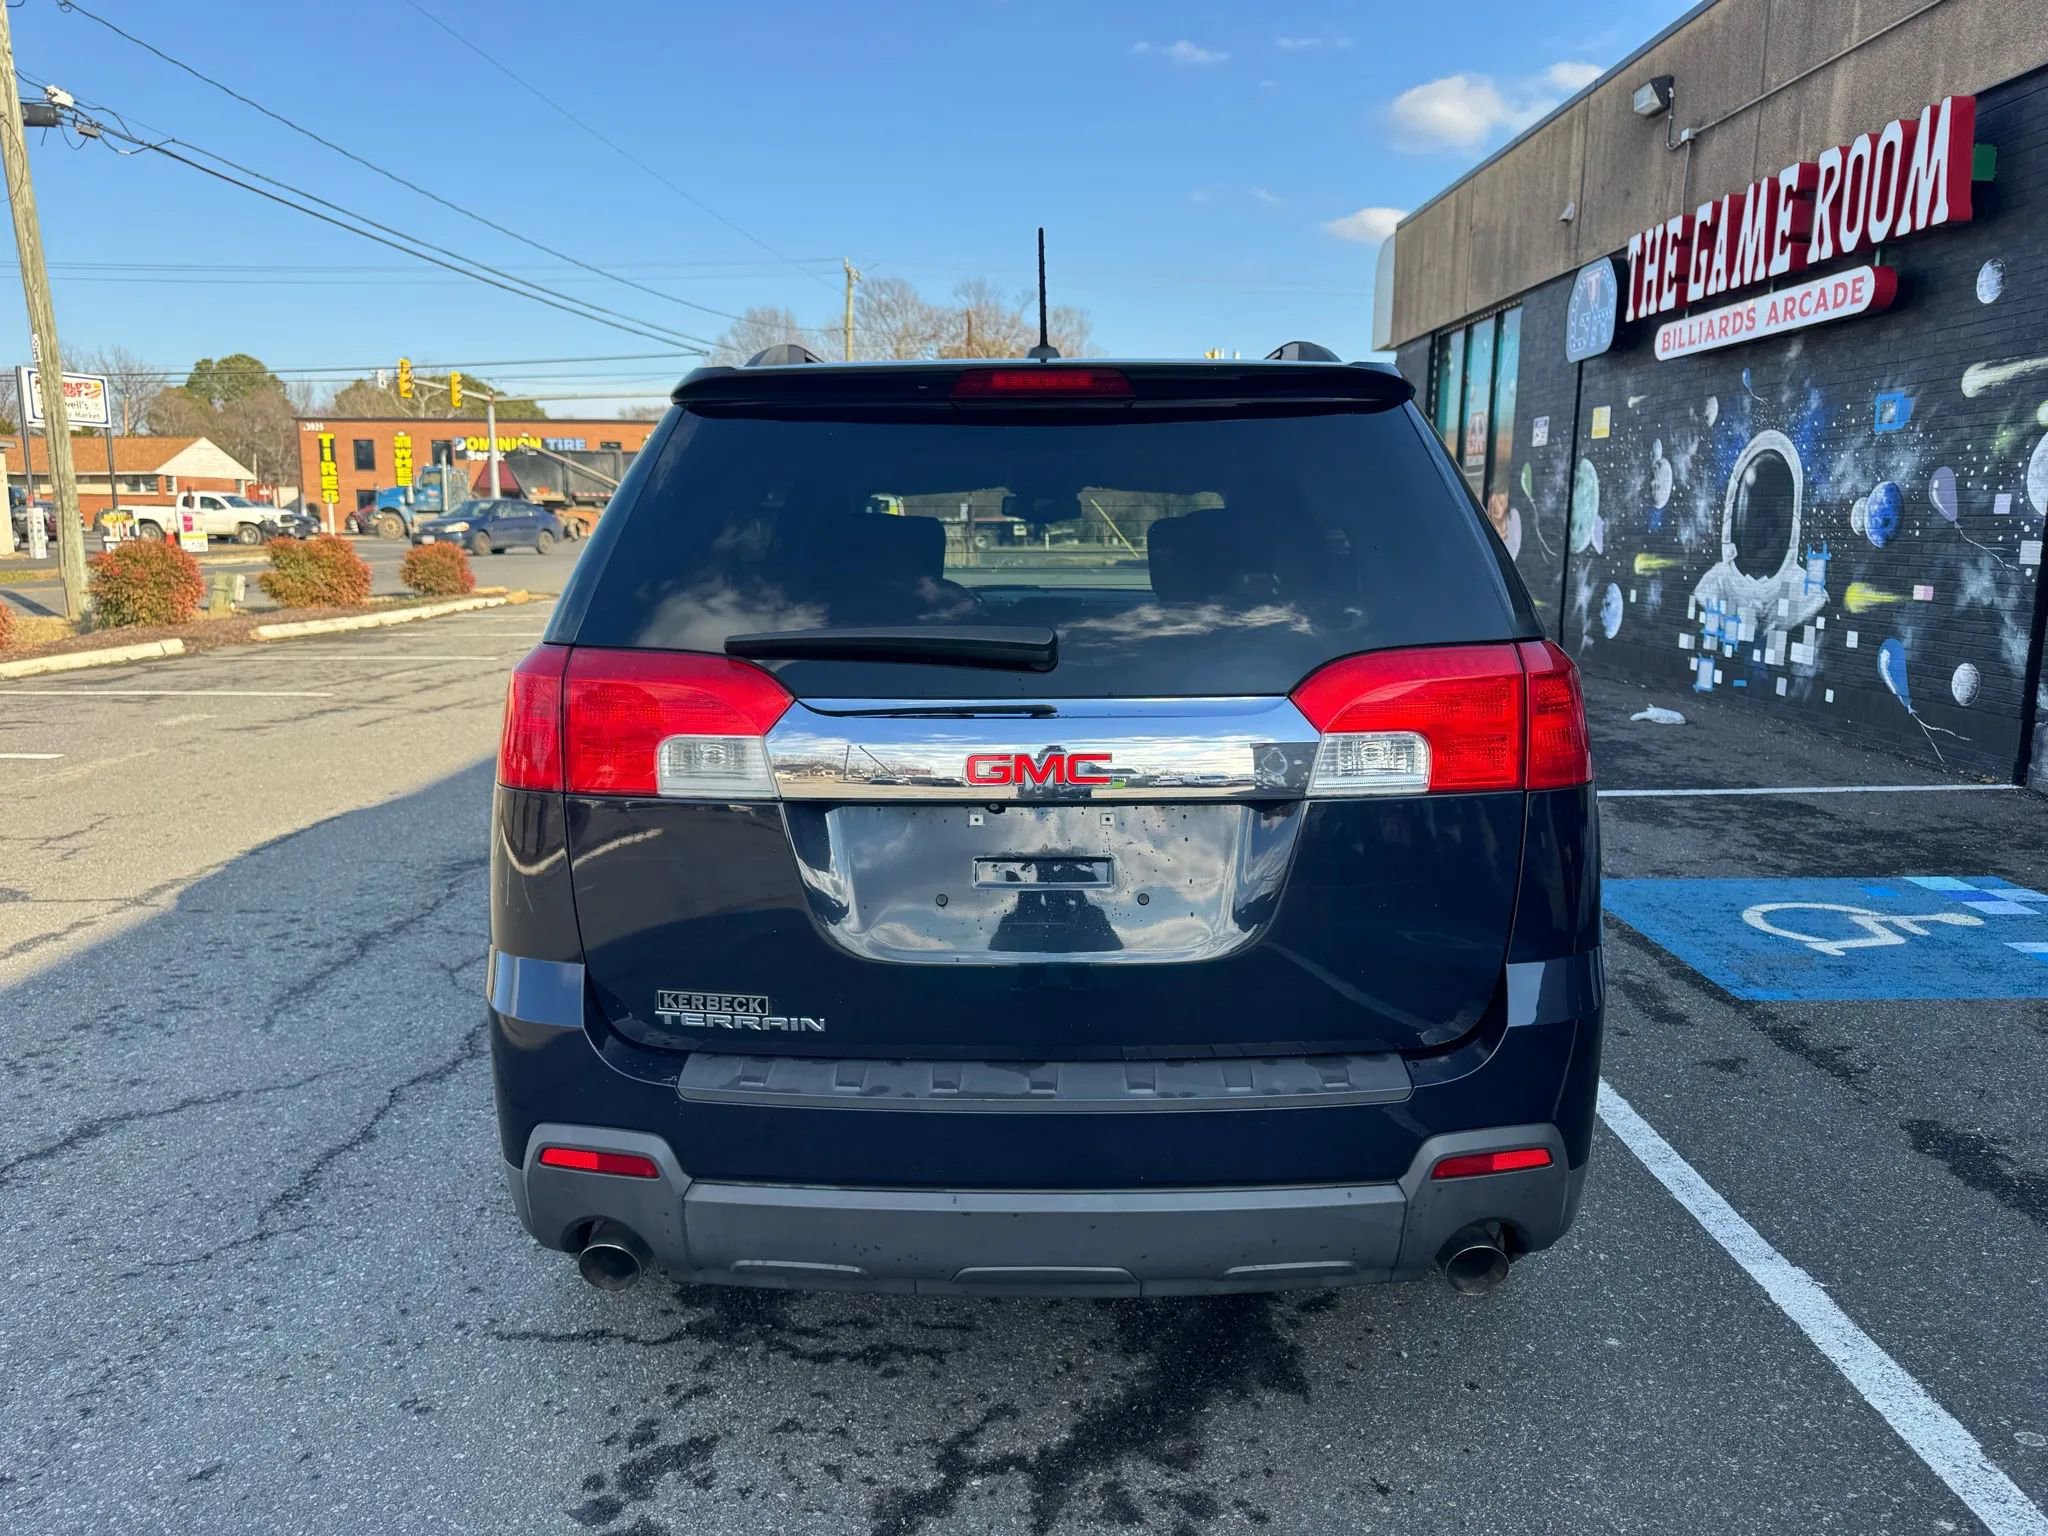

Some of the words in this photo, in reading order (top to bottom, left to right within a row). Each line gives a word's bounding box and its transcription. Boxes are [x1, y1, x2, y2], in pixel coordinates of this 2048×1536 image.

[1625, 214, 1683, 323] THE
[1687, 162, 1800, 303] GAME
[1807, 95, 1952, 265] ROOM
[1661, 306, 1757, 353] BILLIARDS
[1765, 275, 1865, 327] ARCADE
[545, 437, 587, 451] TIRE
[317, 432, 340, 504] TIRES
[965, 753, 1113, 785] GMC
[663, 993, 763, 1014] KERBECK
[655, 1010, 826, 1032] TERRAIN
